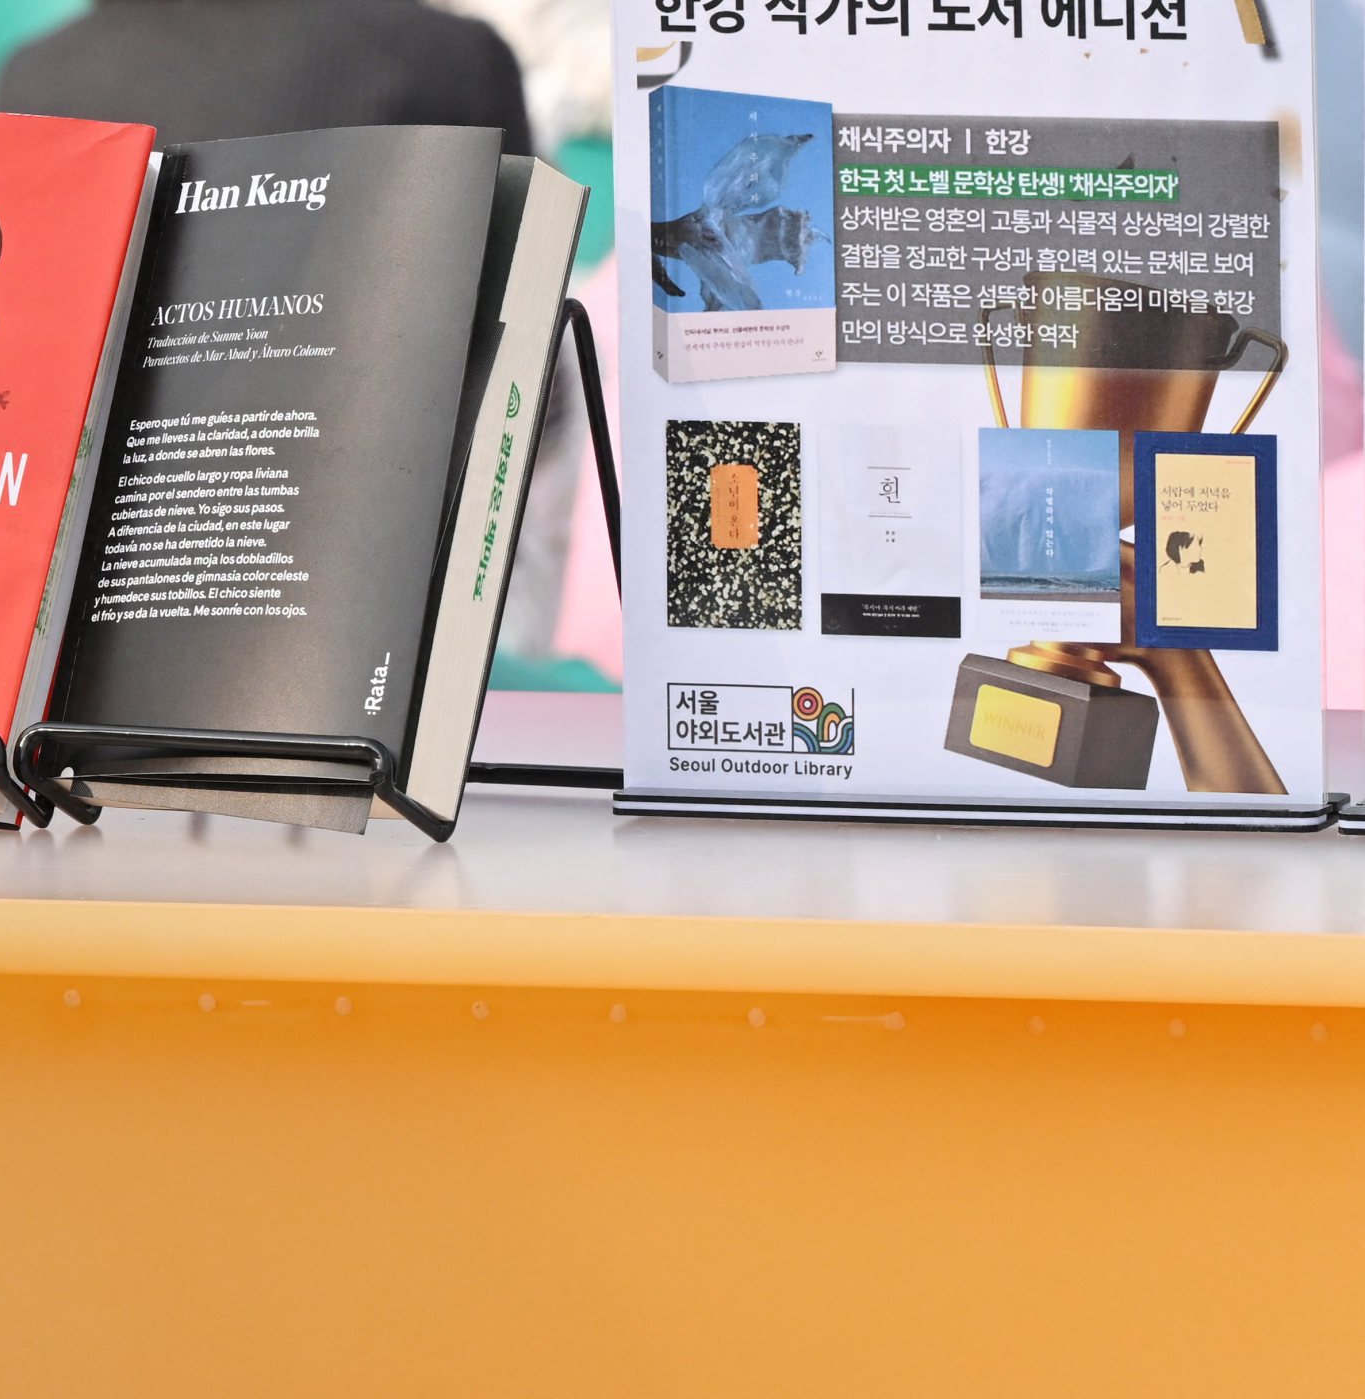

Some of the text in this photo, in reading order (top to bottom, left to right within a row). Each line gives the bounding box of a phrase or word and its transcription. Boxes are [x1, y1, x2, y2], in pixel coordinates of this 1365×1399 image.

[838, 126, 952, 154] 채식주의자
[985, 128, 1031, 156] 한강
[175, 173, 331, 214] Han Kang
[839, 168, 881, 193] 한국
[884, 169, 905, 194] 첫
[908, 170, 950, 194] 노벨
[953, 170, 1015, 196] 문학상
[1018, 171, 1065, 197] 탄생!
[840, 206, 1270, 239] 상처받은 영혼의 고통과 식물적 상상력의 강렬한
[841, 243, 1254, 277] 결합을 정교한 구성과 흡인력 있는 문체로 보여
[151, 293, 324, 327] ACTOS HUMANOS
[841, 282, 1255, 315] 주는 이 작품은 섬뜩한 아름다움의 미학을 한강
[147, 328, 268, 349] Traducción de Sunme Yoon
[842, 319, 1079, 349] 만의 방식으로 완성한 역작
[143, 351, 189, 368] Paratextos
[190, 351, 201, 363] de
[203, 349, 224, 362] Mar
[224, 347, 250, 360] Abad
[250, 350, 258, 362] y
[293, 345, 336, 357] Colomer
[129, 410, 317, 433] Espero que tú me guíes a partir de ahora.
[126, 426, 320, 448] Que me lleves a la claridad, a donde brilla
[879, 475, 901, 504] 흰
[676, 689, 719, 716] 서울
[676, 719, 786, 747] 야외도서관
[669, 756, 853, 780] Seoul Outdoor Library
